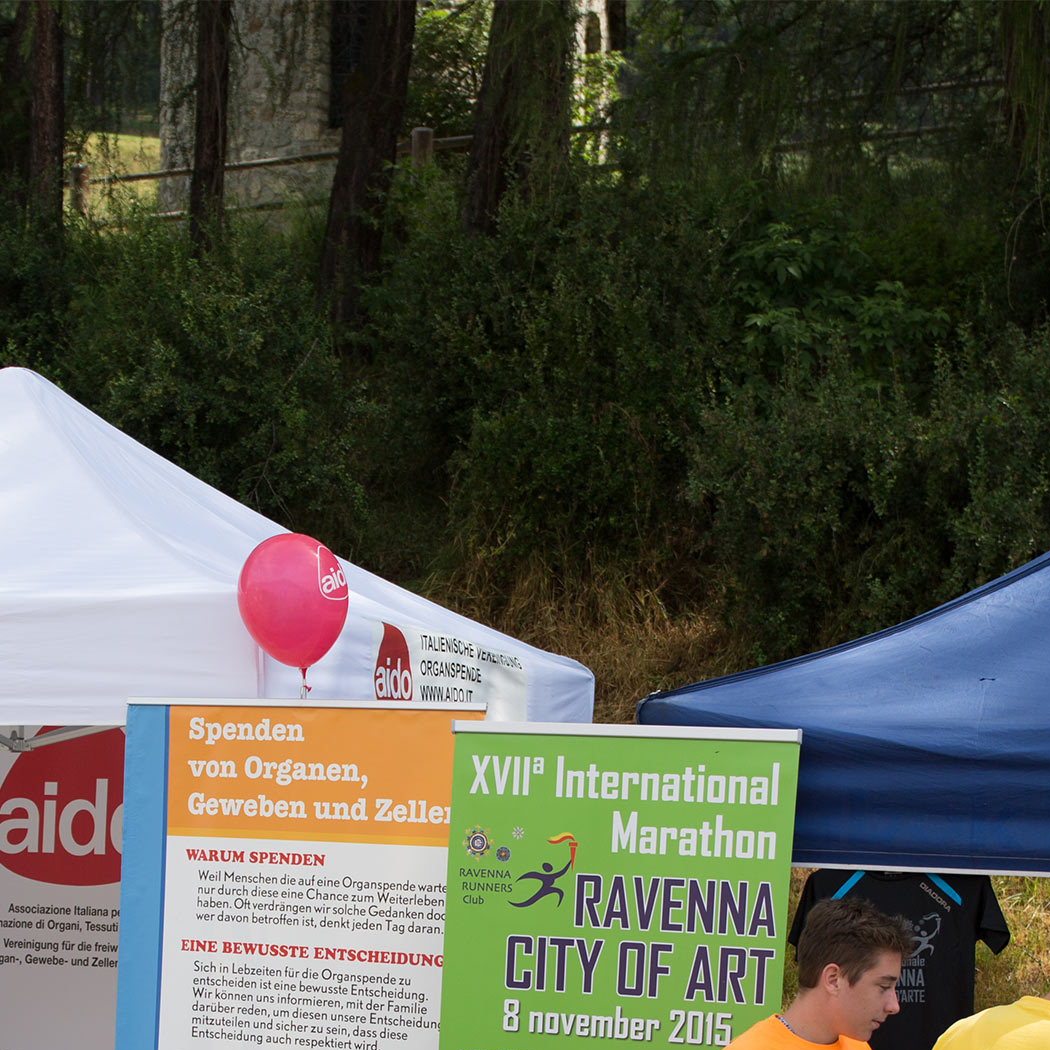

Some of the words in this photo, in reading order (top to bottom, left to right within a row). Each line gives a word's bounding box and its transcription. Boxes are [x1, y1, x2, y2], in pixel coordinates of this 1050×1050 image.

[420, 634, 475, 657] ITALIENISCHE
[375, 657, 412, 700] aido
[420, 659, 482, 683] ORGANSPENDE
[420, 685, 473, 703] WWW.AIDO.IT
[188, 717, 305, 745] Spenden
[188, 759, 238, 778] von
[244, 756, 368, 790] Organen,
[556, 755, 780, 806] International
[188, 793, 307, 819] Geweben
[314, 798, 368, 821] und
[611, 811, 777, 860] Marathon
[186, 849, 245, 863] WARUM
[249, 851, 326, 866] SPENDEN
[198, 869, 222, 882] Weil
[224, 871, 278, 885] Menschen
[280, 873, 297, 886] die
[298, 874, 316, 887] auf
[317, 877, 341, 888] eine
[342, 875, 416, 894] Organspende
[459, 867, 511, 880] RAVENNA
[197, 886, 215, 895] nur
[217, 883, 249, 897] durch
[251, 885, 279, 898] diese
[281, 889, 304, 899] eine
[305, 888, 349, 902] Chance
[351, 894, 375, 903] zum
[377, 892, 445, 907] Weiterleben
[462, 881, 513, 893] RUNNERS
[462, 893, 485, 905] Club
[919, 882, 952, 912] DIADORA
[8, 903, 71, 916] Associazione
[74, 905, 109, 917] Italiana
[196, 897, 232, 909] haben.
[233, 897, 251, 910] Oft
[252, 899, 312, 915] verdrängen
[313, 903, 331, 915] wir
[332, 902, 366, 916] solche
[368, 905, 425, 920] Gedanken
[572, 873, 775, 937] RAVENNA
[36, 919, 45, 930] di
[47, 919, 82, 933] Organi,
[85, 920, 119, 932] Tessuti
[195, 913, 215, 921] wer
[217, 911, 249, 923] davon
[251, 912, 300, 926] betroffen
[301, 915, 318, 928] ist,
[319, 916, 351, 929] denkt
[351, 919, 383, 933] jeden
[385, 919, 405, 935] Tag
[407, 921, 445, 936] daran.
[3, 938, 59, 953] Vereinigung
[62, 940, 76, 951] für
[77, 941, 93, 952] die
[181, 939, 218, 953] EINE
[222, 941, 309, 959] BEWUSSTE
[314, 947, 444, 968] ENTSCHEIDUNG
[25, 954, 68, 966] Gewebe-
[71, 956, 89, 967] und
[505, 935, 604, 995] CITY
[616, 941, 673, 998] OF
[684, 944, 776, 1006] ART
[503, 999, 520, 1032] 8
[529, 1006, 660, 1042] november
[668, 1010, 733, 1047] 2015
